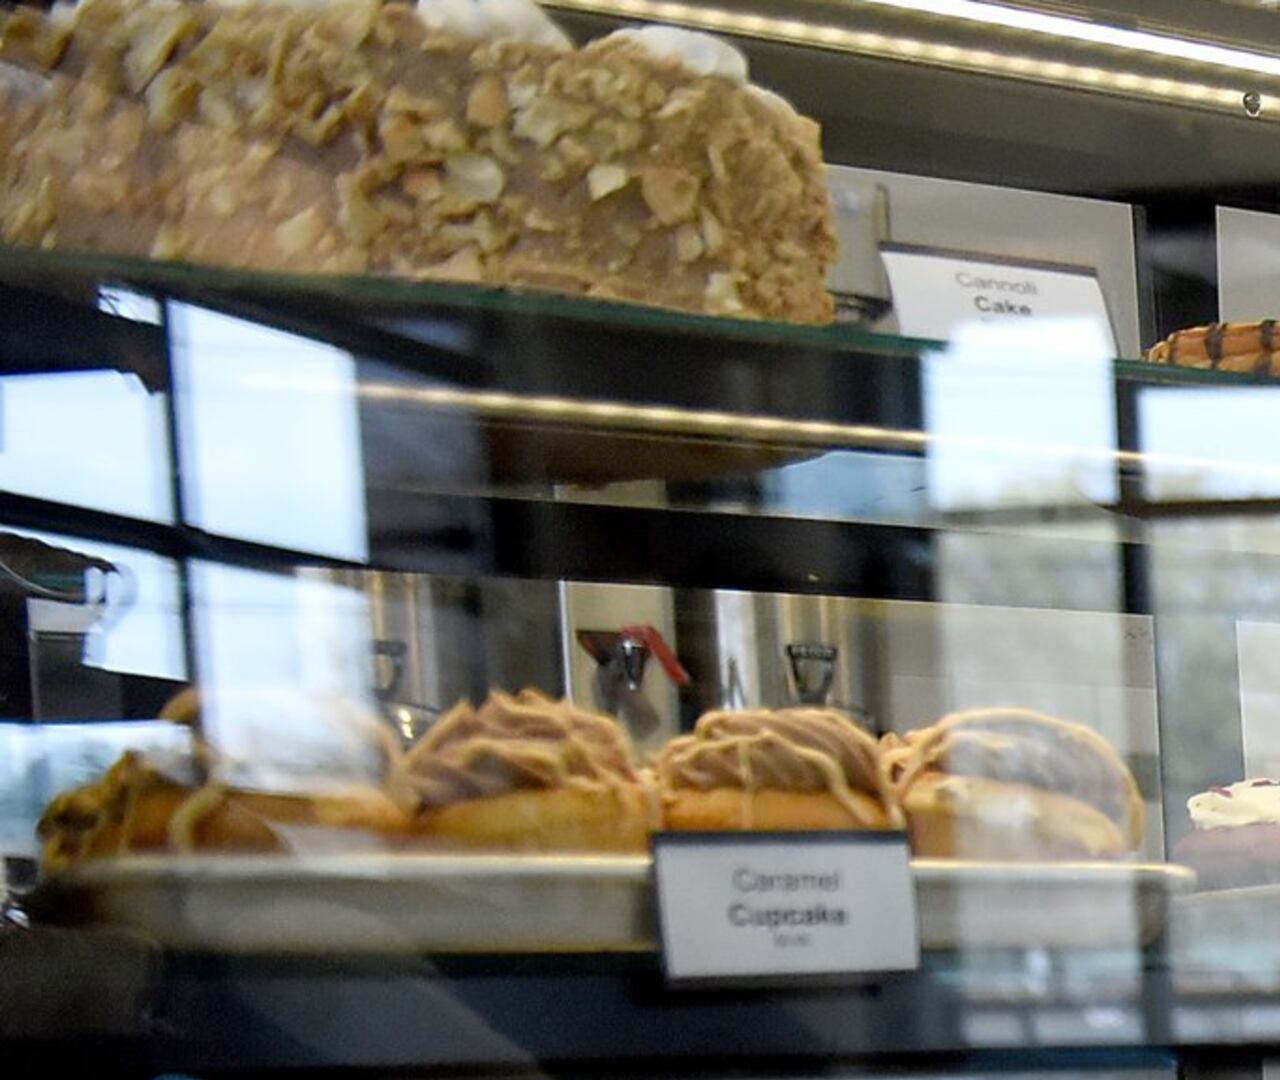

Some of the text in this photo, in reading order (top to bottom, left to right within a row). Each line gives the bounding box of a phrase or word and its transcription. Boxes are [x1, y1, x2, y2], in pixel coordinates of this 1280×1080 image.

[955, 271, 1038, 295] Cannoli
[973, 295, 1032, 316] Cake
[731, 867, 840, 892] Caramel
[727, 903, 848, 930] Cupcake
